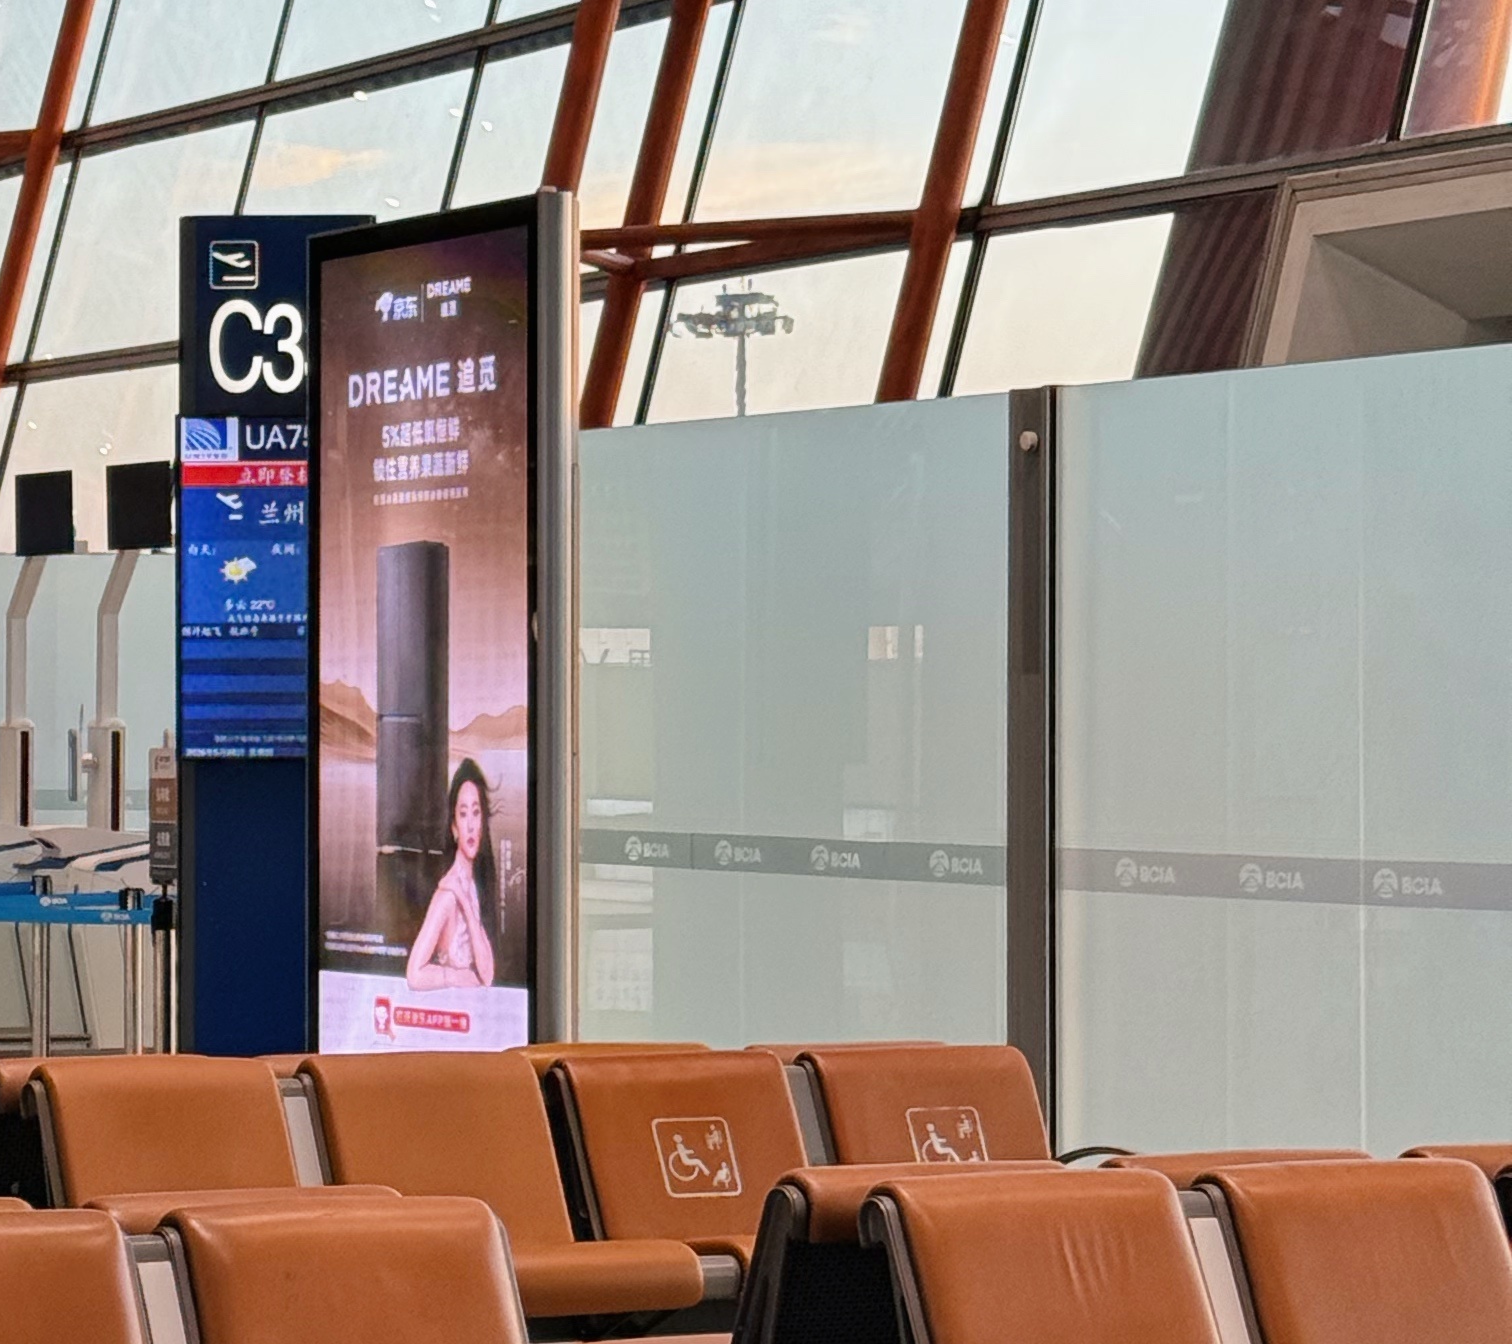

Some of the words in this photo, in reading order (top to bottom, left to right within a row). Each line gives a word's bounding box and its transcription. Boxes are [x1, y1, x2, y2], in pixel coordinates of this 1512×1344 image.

[209, 299, 308, 394] C3
[348, 362, 451, 408] DREAME
[258, 500, 305, 525] 兰州
[642, 842, 670, 859] BCIA
[734, 847, 762, 864] BCIA
[830, 852, 861, 870] BCIA
[951, 856, 983, 876] BCIA
[1138, 865, 1176, 885] BCIA
[1265, 870, 1305, 891] BCIA
[1401, 875, 1444, 897] BCIA
